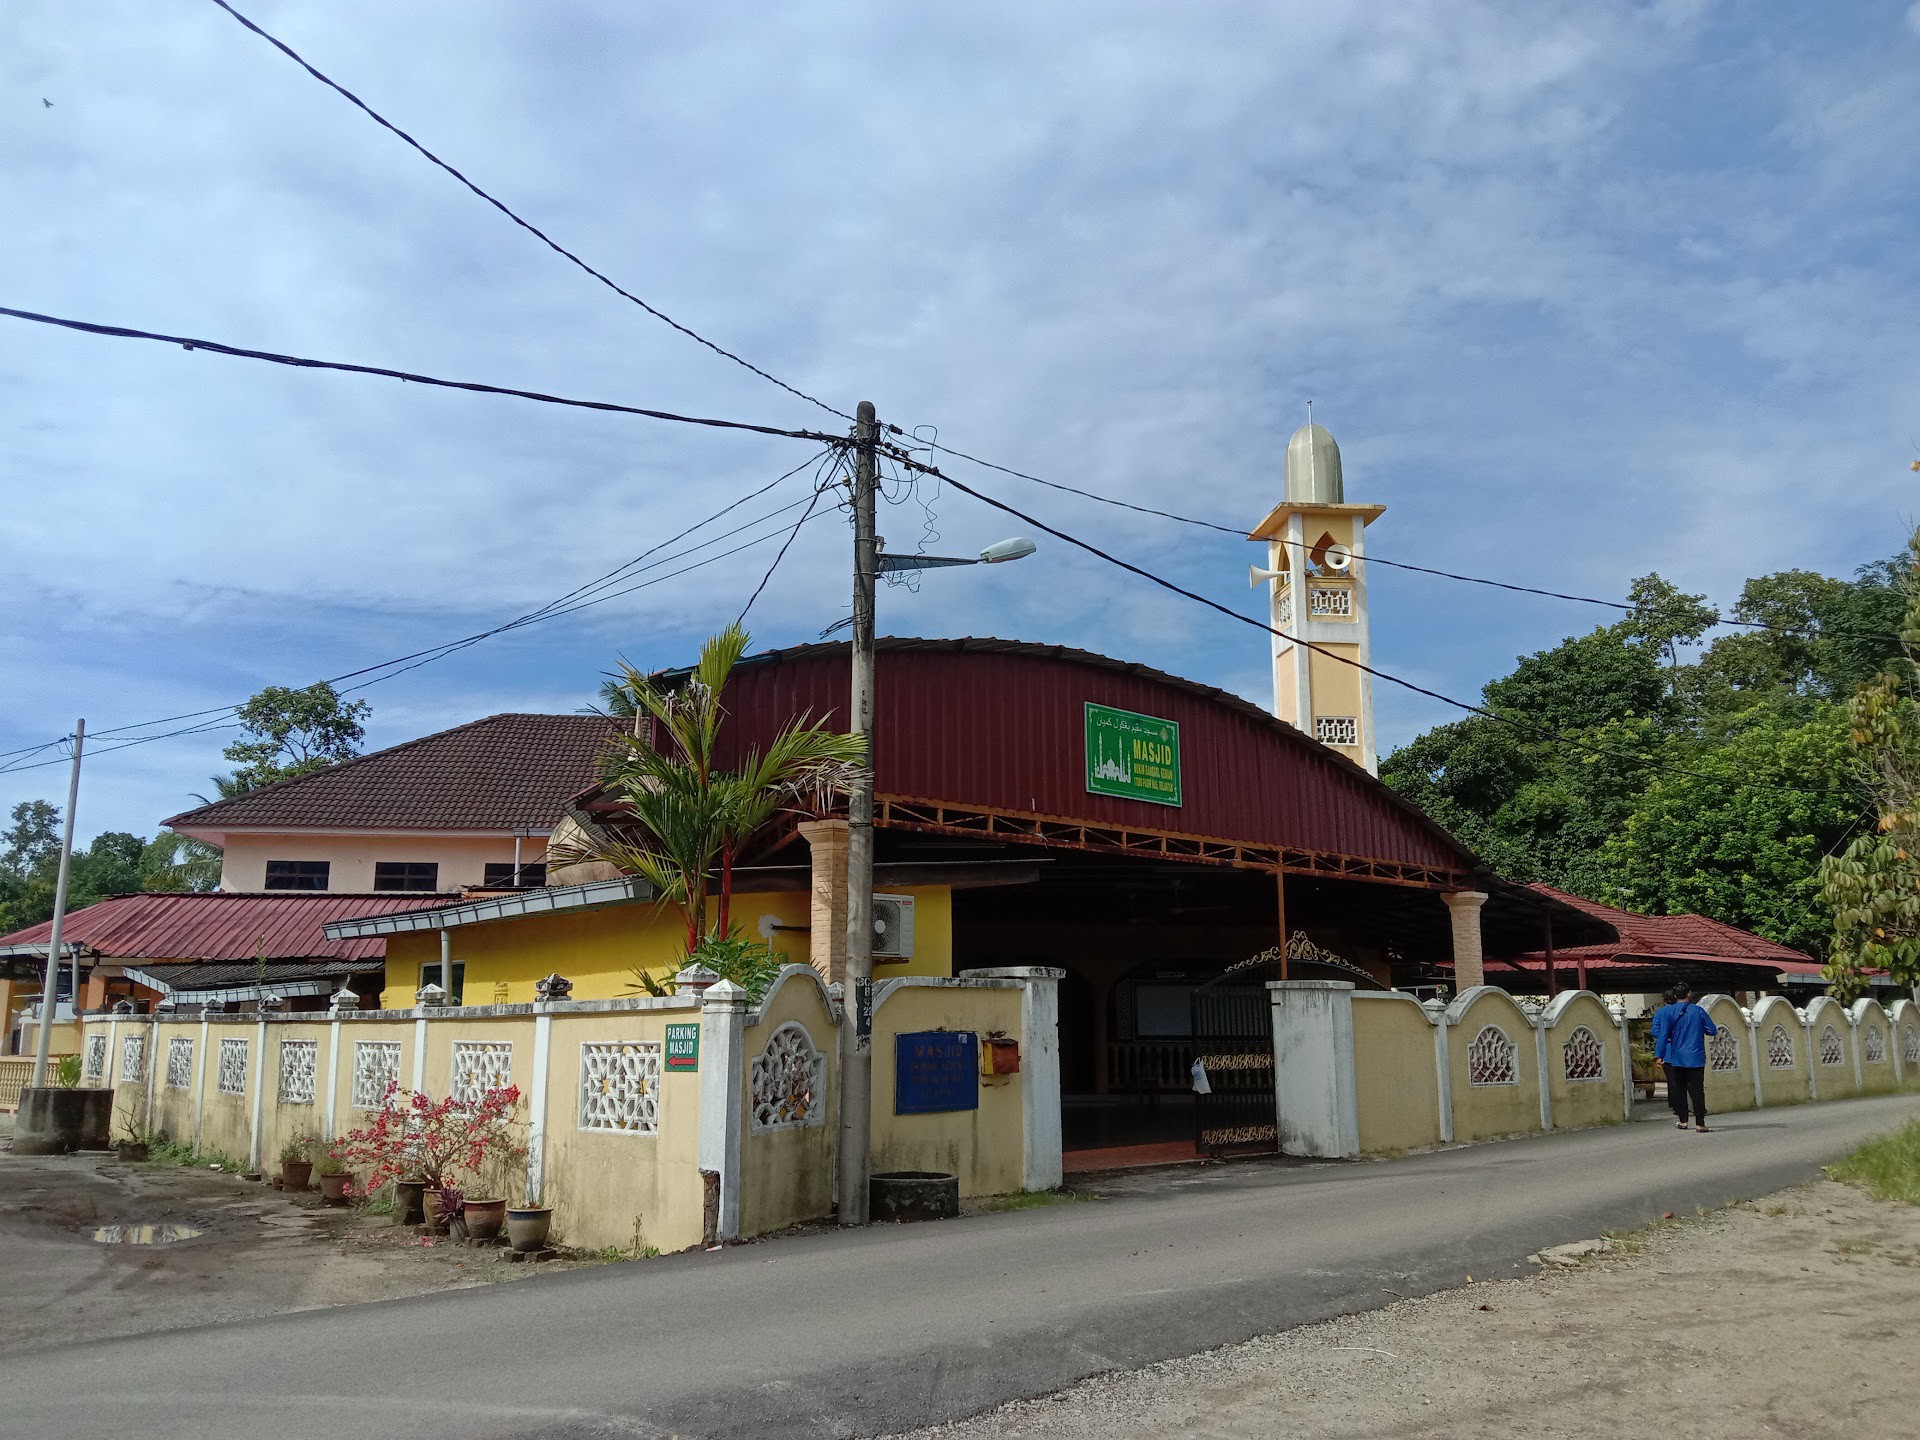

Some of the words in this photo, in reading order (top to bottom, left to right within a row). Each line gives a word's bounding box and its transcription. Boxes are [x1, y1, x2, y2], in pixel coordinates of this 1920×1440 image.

[1133, 739, 1172, 766] MASJID
[667, 1027, 696, 1040] PARKING
[669, 1041, 694, 1055] MASJID
[915, 1043, 963, 1058] MASJID
